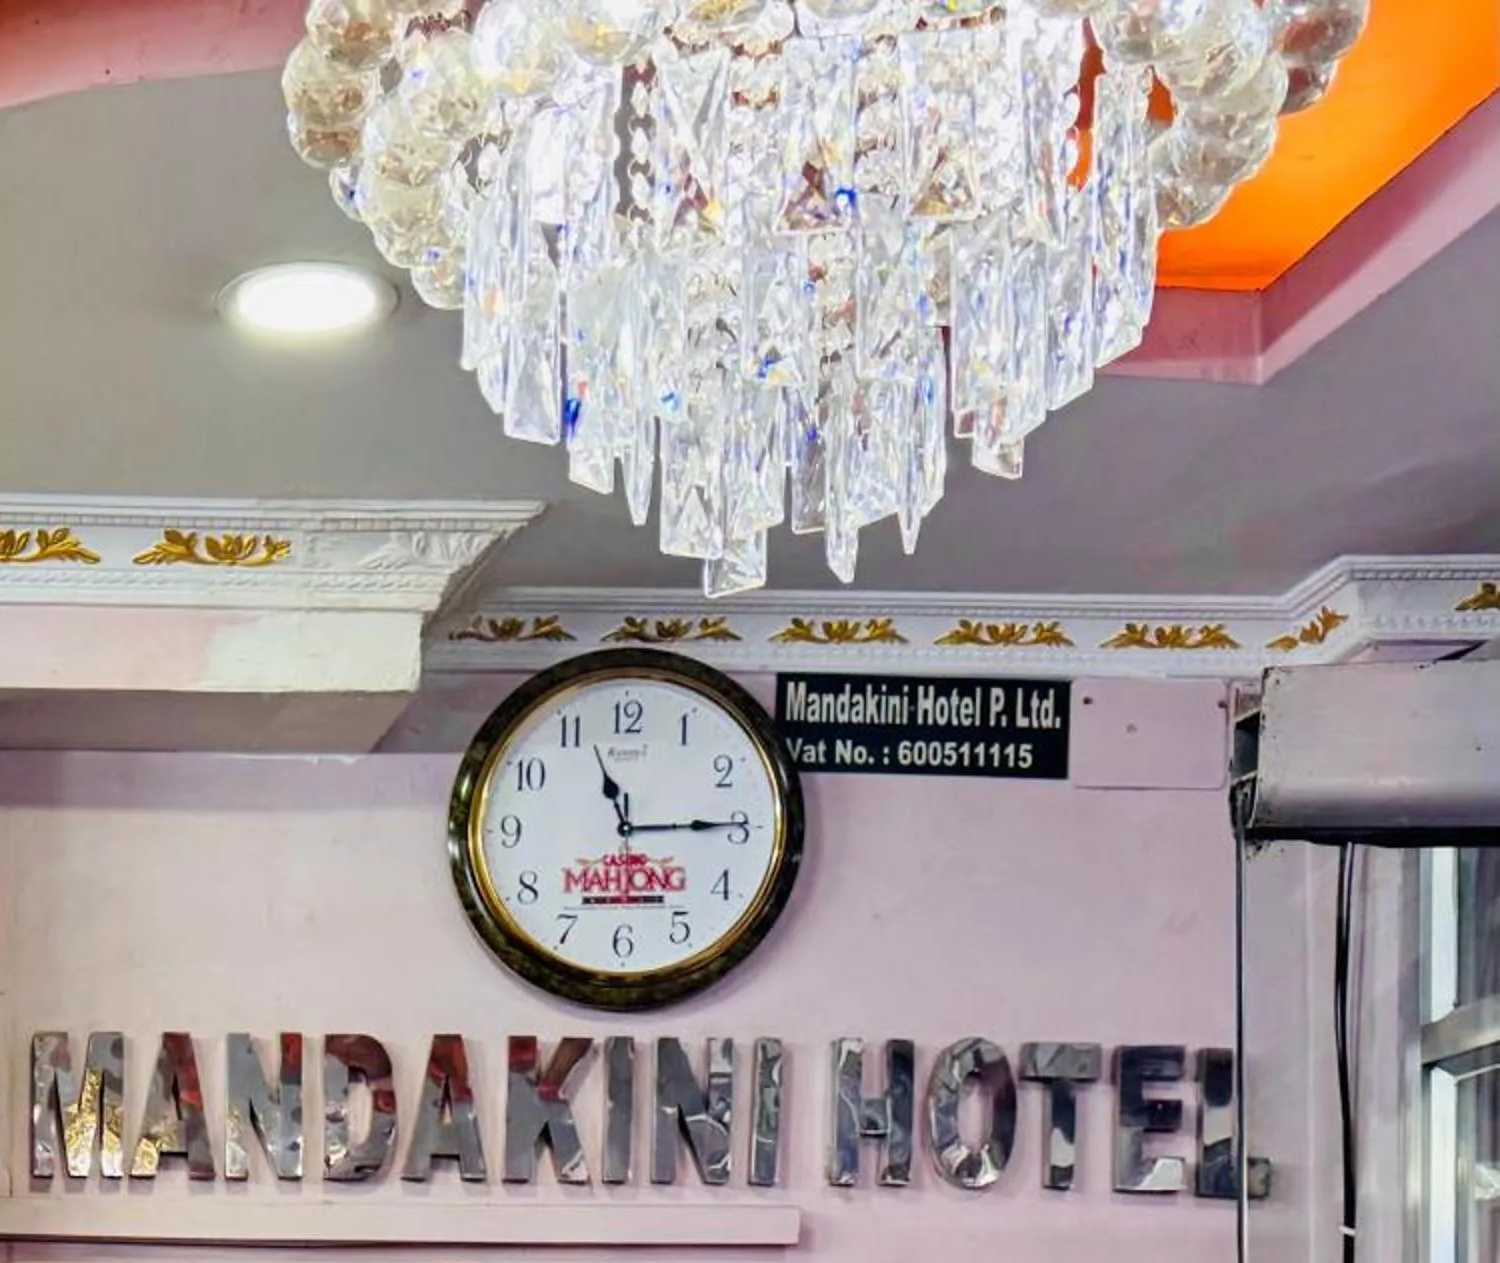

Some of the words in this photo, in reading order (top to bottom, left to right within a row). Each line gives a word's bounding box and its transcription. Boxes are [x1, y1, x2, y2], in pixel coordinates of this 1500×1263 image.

[612, 703, 643, 735] 12
[786, 681, 909, 725] Mandakini
[917, 685, 982, 727] Hotel
[989, 687, 1007, 727] P.
[1016, 687, 1061, 729] Ltd.
[559, 715, 581, 748] 11
[678, 717, 690, 747] 1
[786, 737, 826, 763] Vat
[835, 739, 874, 764] No.
[897, 740, 1032, 768] 600511115
[515, 756, 546, 791] 10
[713, 755, 733, 787] 2
[501, 816, 522, 848] 9
[727, 810, 750, 845] 3
[517, 871, 539, 903] 8
[562, 866, 687, 895] MAHJONG
[710, 870, 731, 901] 4
[556, 912, 579, 945] 7
[612, 924, 634, 958] 6
[670, 911, 691, 945] 5
[29, 1032, 782, 1188] MANDAKINI
[827, 1036, 1271, 1198] HOTEL
